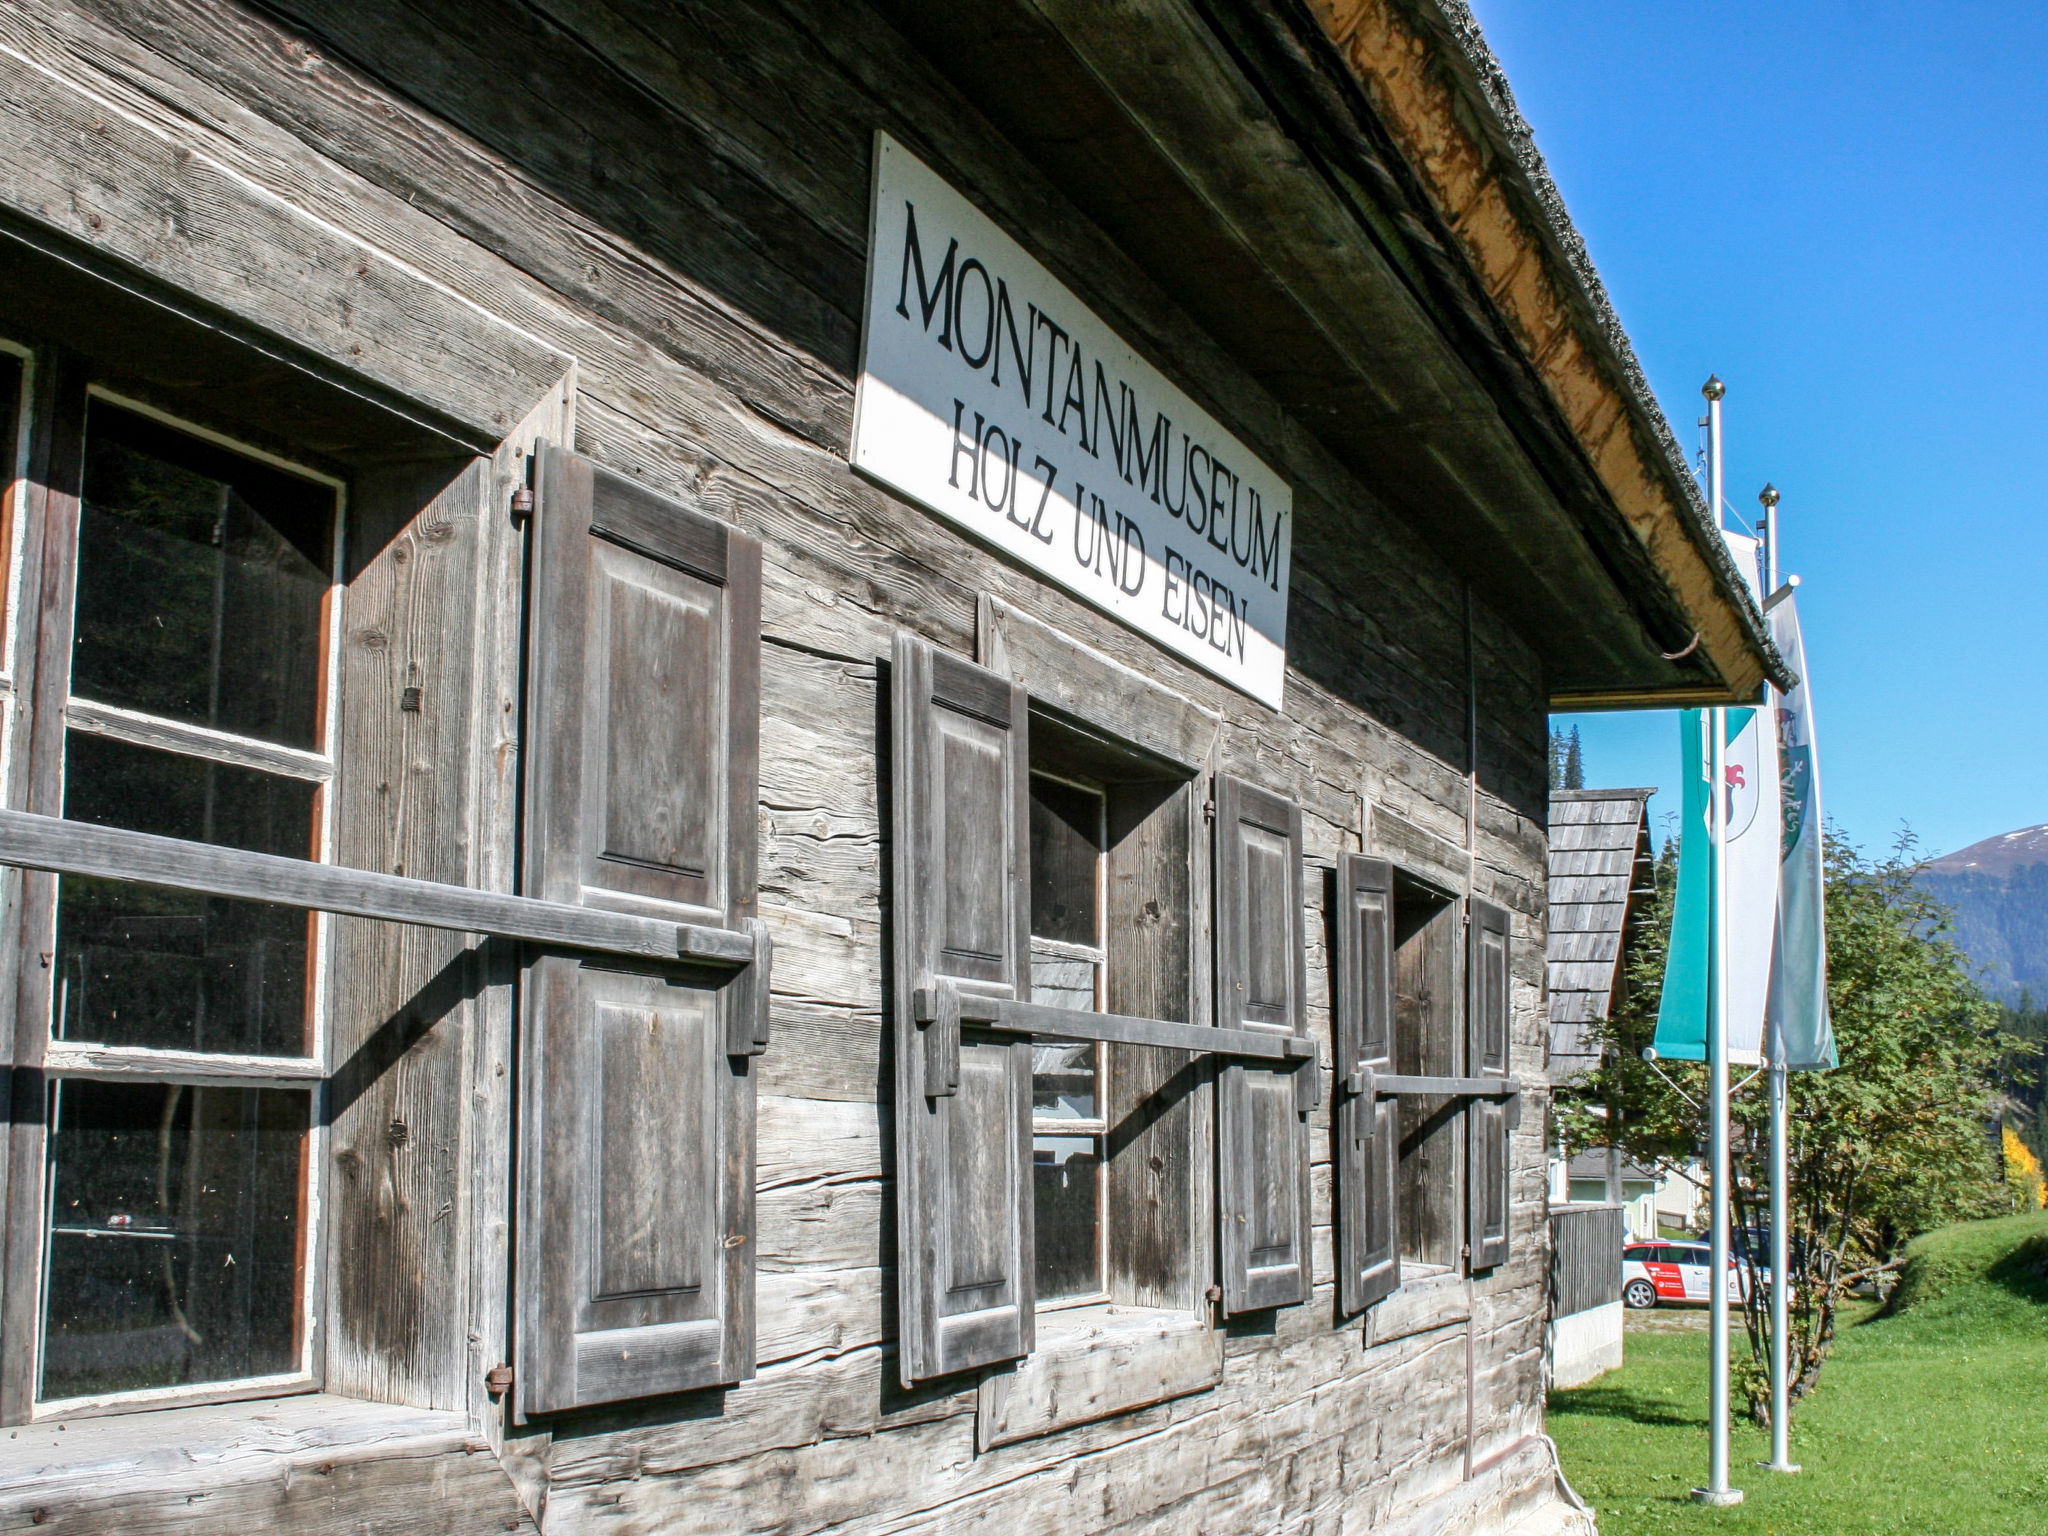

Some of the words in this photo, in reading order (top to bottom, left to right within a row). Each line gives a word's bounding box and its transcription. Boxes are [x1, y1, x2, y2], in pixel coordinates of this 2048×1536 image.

[896, 201, 1281, 592] MONTANMUSEUM
[948, 398, 1057, 545] HOLZ
[1074, 482, 1145, 597] UND
[1162, 545, 1247, 665] EISEN
